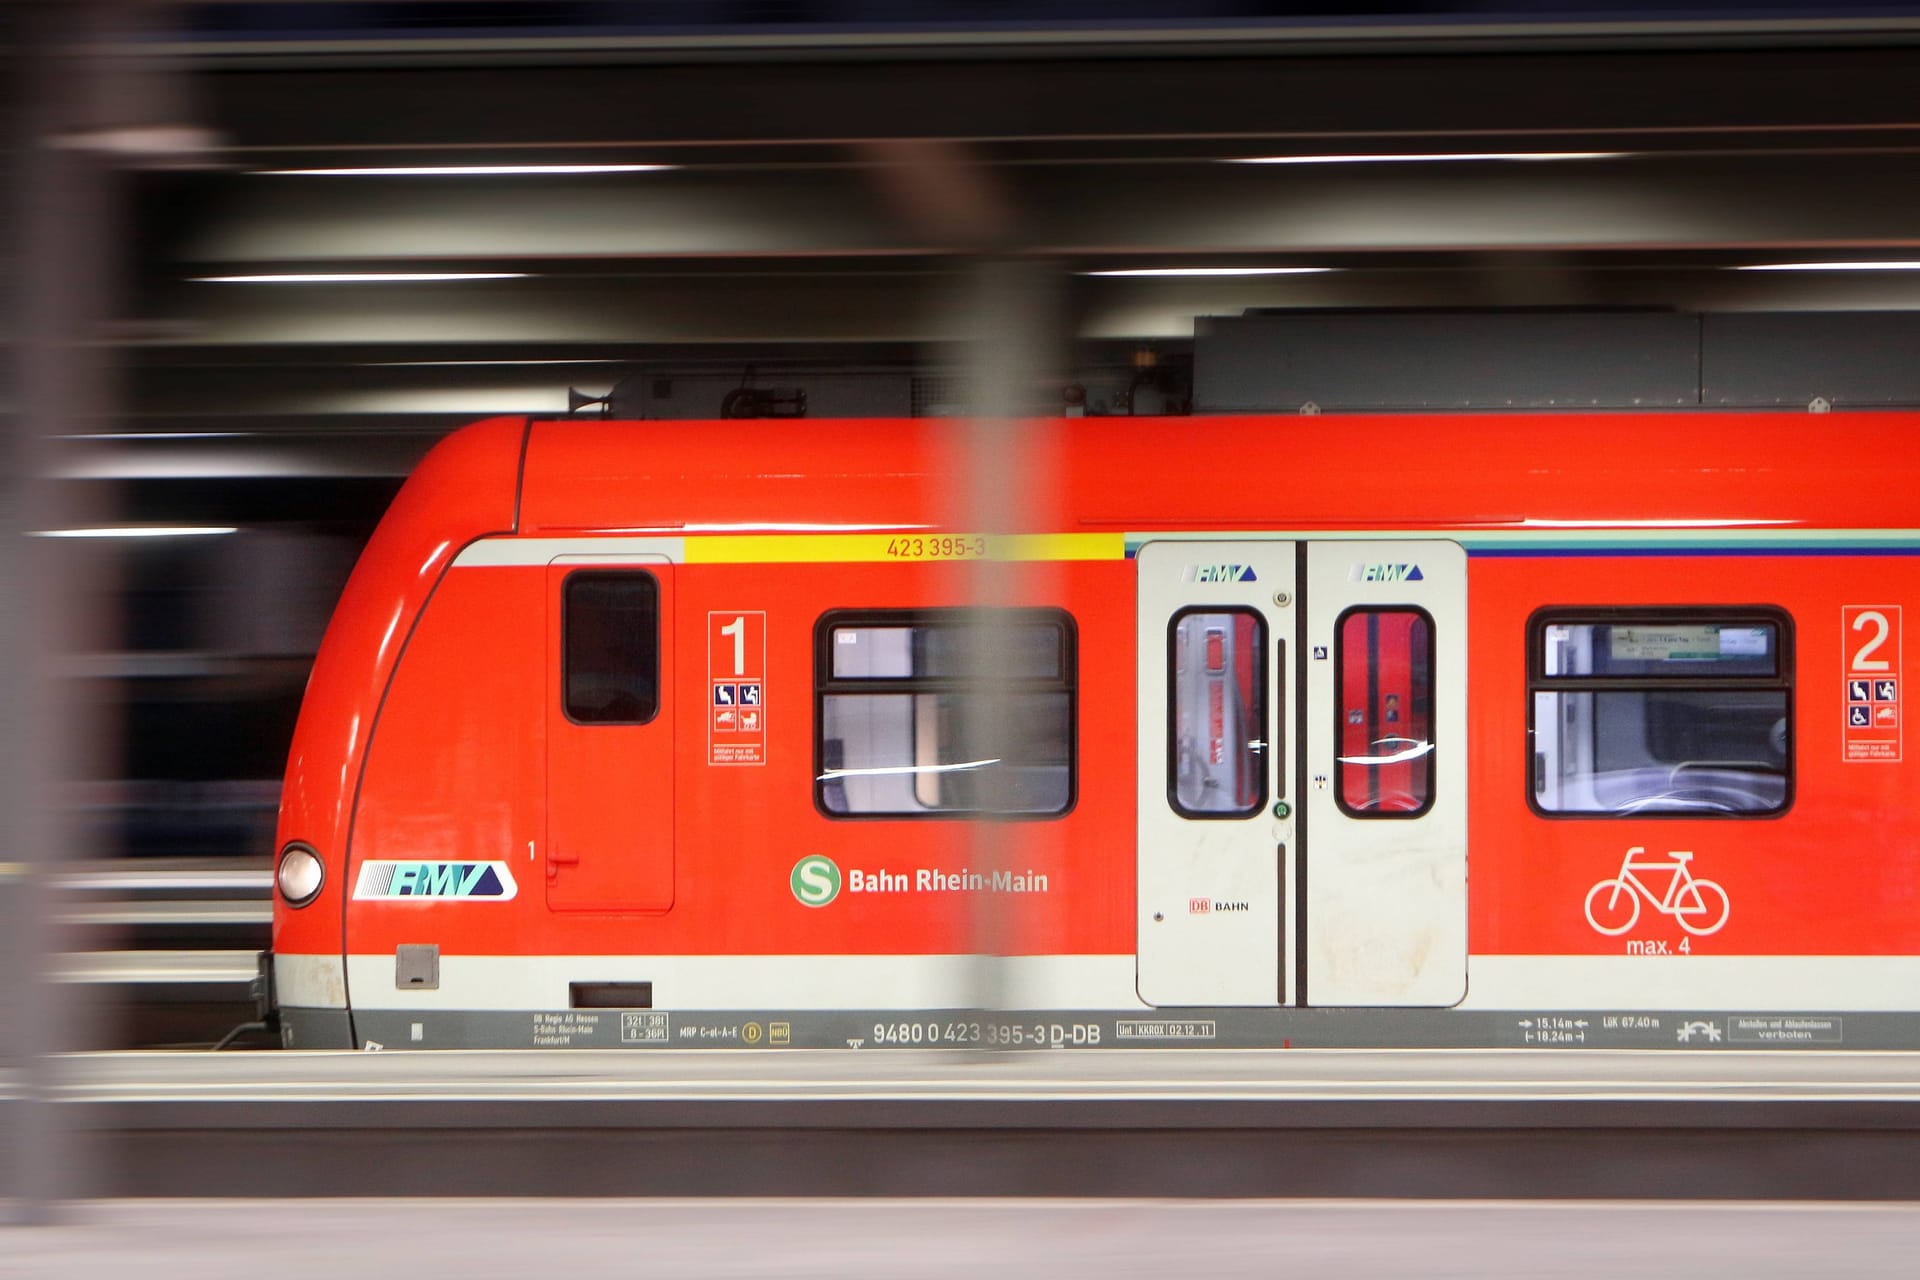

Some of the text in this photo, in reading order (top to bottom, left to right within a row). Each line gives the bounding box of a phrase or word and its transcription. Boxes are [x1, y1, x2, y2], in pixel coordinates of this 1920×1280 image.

[887, 537, 985, 557] 423 395-3
[721, 616, 745, 676] 1
[1851, 610, 1889, 671] 2
[528, 841, 535, 860] 1
[387, 864, 504, 896] RMV
[800, 860, 1049, 900] S Bahn Rhein-Main
[1190, 899, 1249, 912] DB BAHN
[1626, 936, 1691, 955] max. 4
[873, 1023, 1101, 1047] 9480 0 423 395-3 D-DB
[1758, 1030, 1812, 1040] verboten
